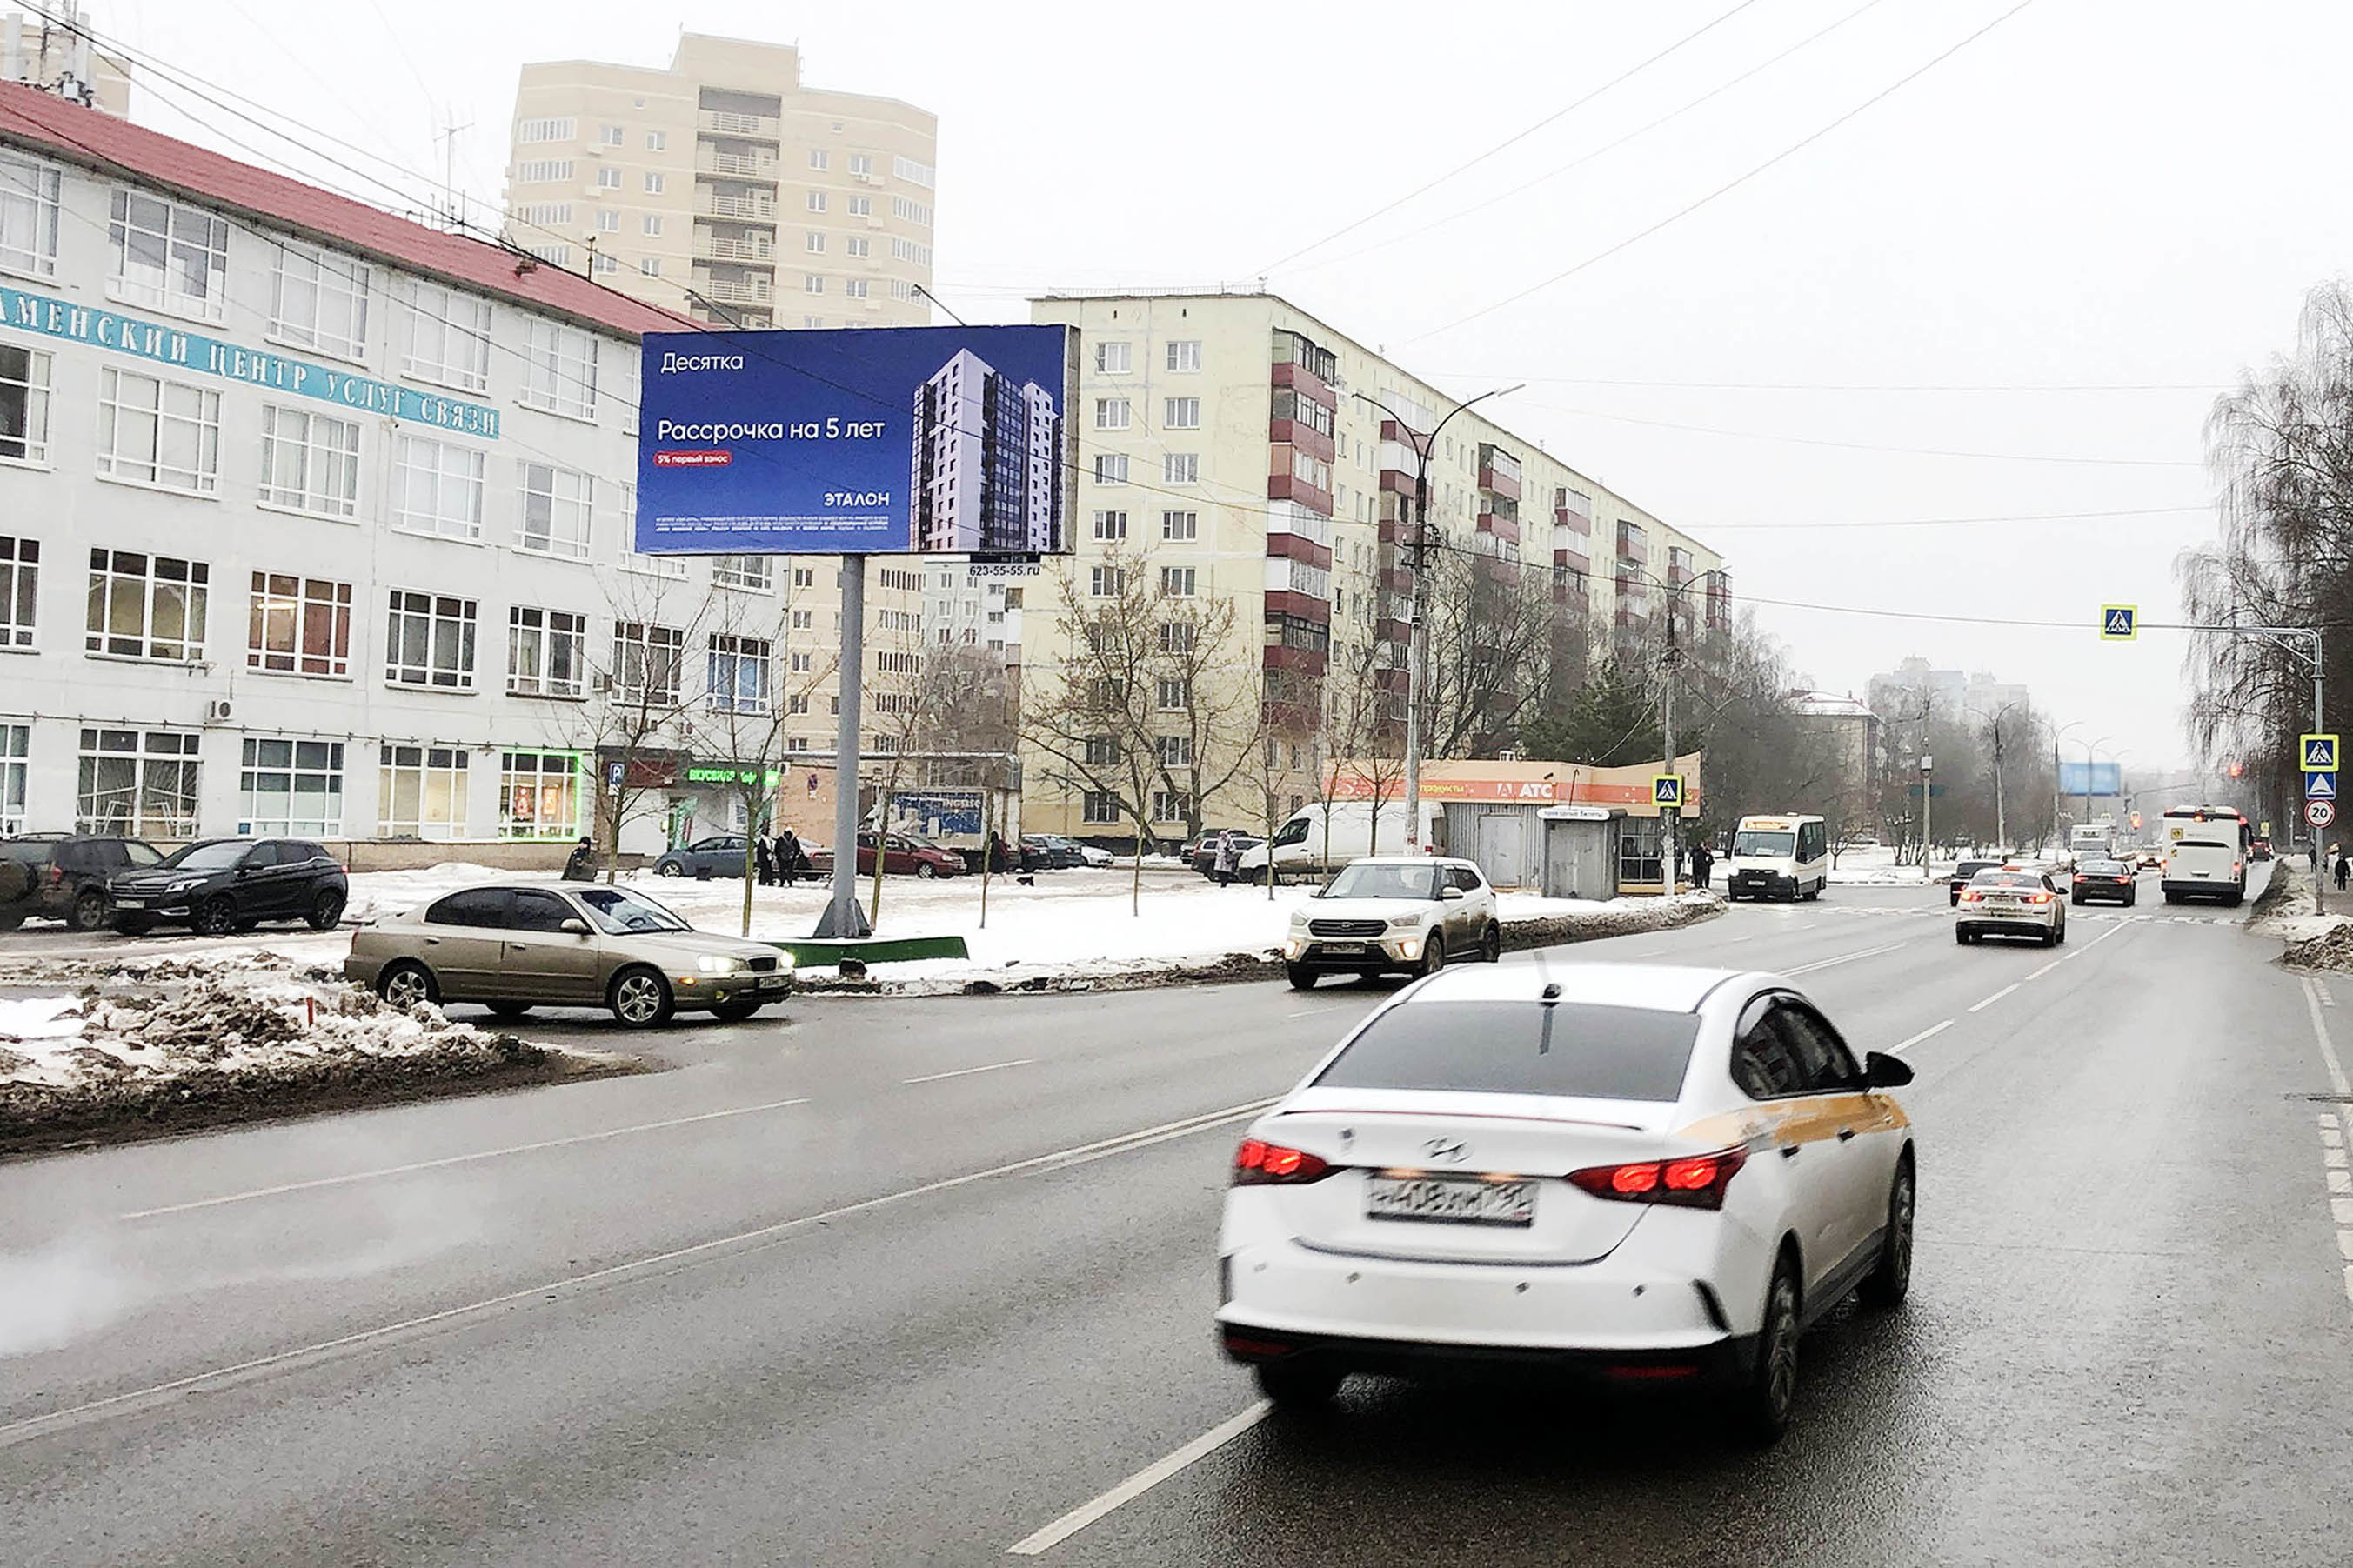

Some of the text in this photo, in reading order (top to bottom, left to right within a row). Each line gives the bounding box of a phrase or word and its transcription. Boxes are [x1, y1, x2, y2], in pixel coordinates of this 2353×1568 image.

[660, 352, 744, 374] Десятка
[210, 344, 307, 390] ЦЕНТР
[326, 374, 404, 414] УСЛУГ
[421, 397, 495, 435] СВЯЗИ
[658, 417, 885, 444] Рассрочка на 5 лет
[658, 455, 671, 464] 5%
[672, 454, 703, 464] первый
[824, 492, 890, 506] ЭТАЛОН
[969, 564, 1040, 576] 623-55-55.ru
[1519, 784, 1553, 798] АТС
[2311, 806, 2328, 818] 20
